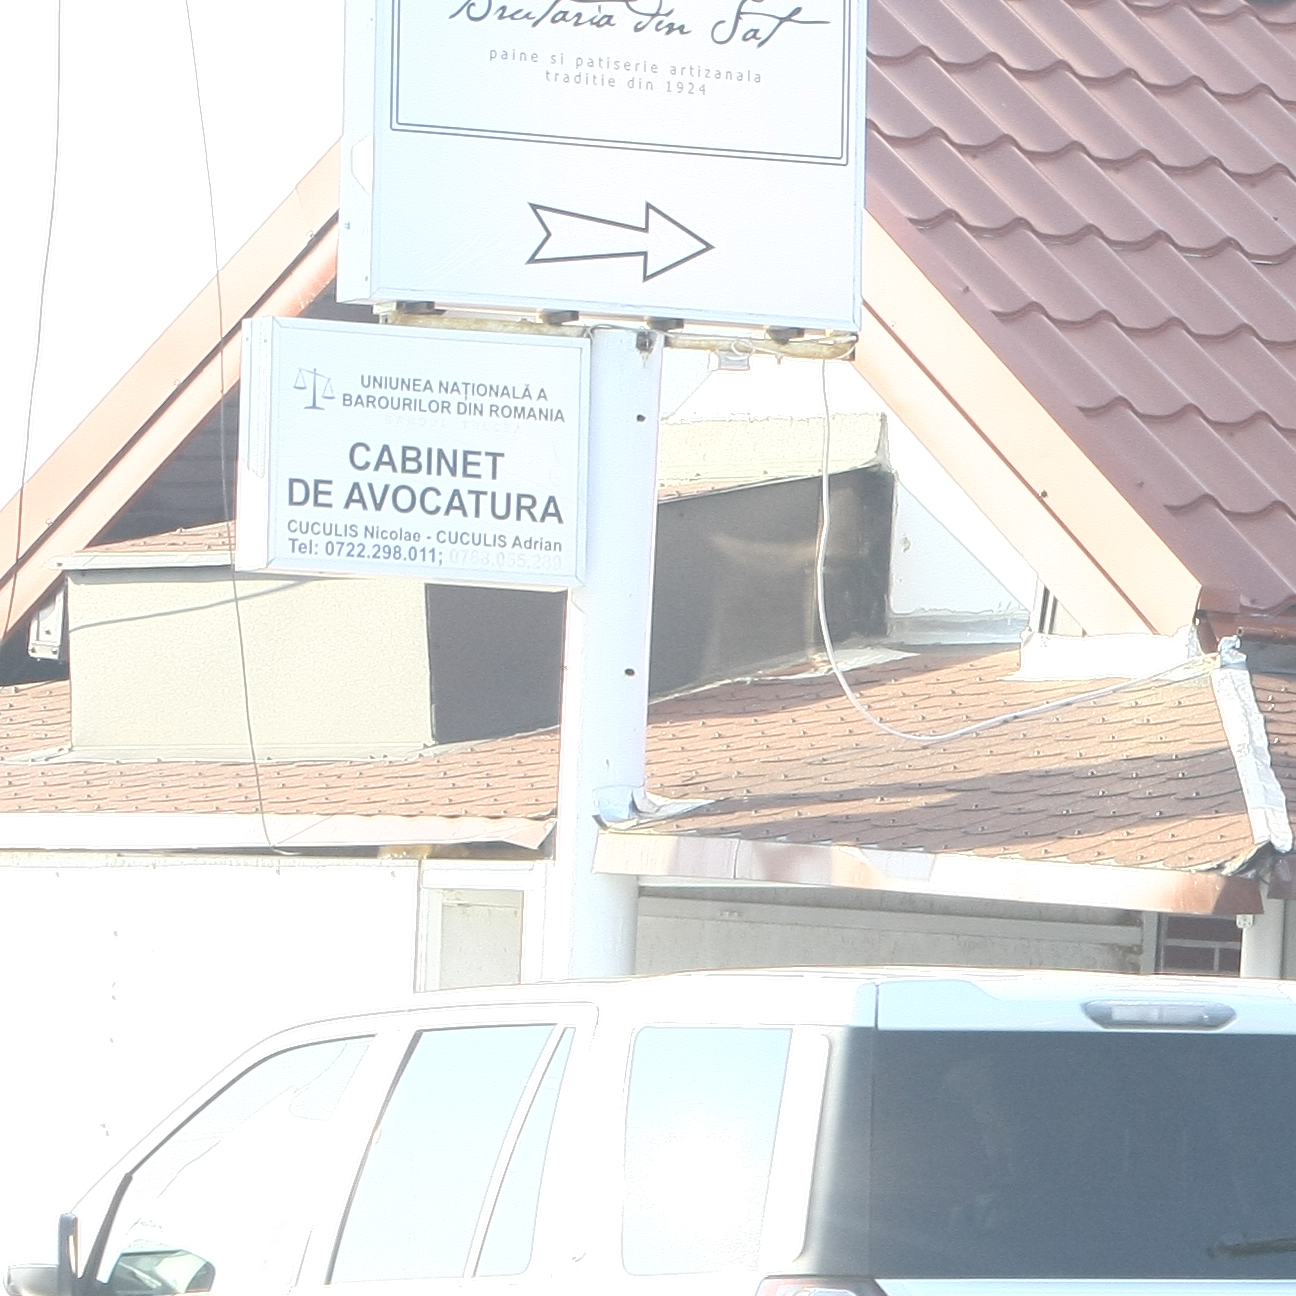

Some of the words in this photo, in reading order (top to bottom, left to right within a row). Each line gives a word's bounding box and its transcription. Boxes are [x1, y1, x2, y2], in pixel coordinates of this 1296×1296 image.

[489, 47, 539, 62] paine
[550, 52, 565, 65] si
[575, 55, 659, 74] patiserie
[669, 63, 763, 84] artizanala
[545, 69, 616, 88] traditie
[627, 77, 653, 92] din
[666, 81, 707, 95] 1924
[360, 373, 434, 393] UNIUNEA
[536, 388, 548, 402] A
[342, 393, 452, 414] BAROURILOR
[456, 401, 484, 417] DIN
[489, 405, 565, 423] ROMANIA
[348, 441, 505, 481] CABINET
[287, 477, 334, 509] DE
[343, 481, 564, 525] AVOCATURA
[287, 519, 358, 538] CUCULIS
[363, 524, 421, 542] Nicolae
[436, 529, 507, 548] CUCULIS
[511, 535, 562, 553] Adrian
[288, 537, 318, 556] Tel:
[325, 540, 443, 566] 0722.298.011;
